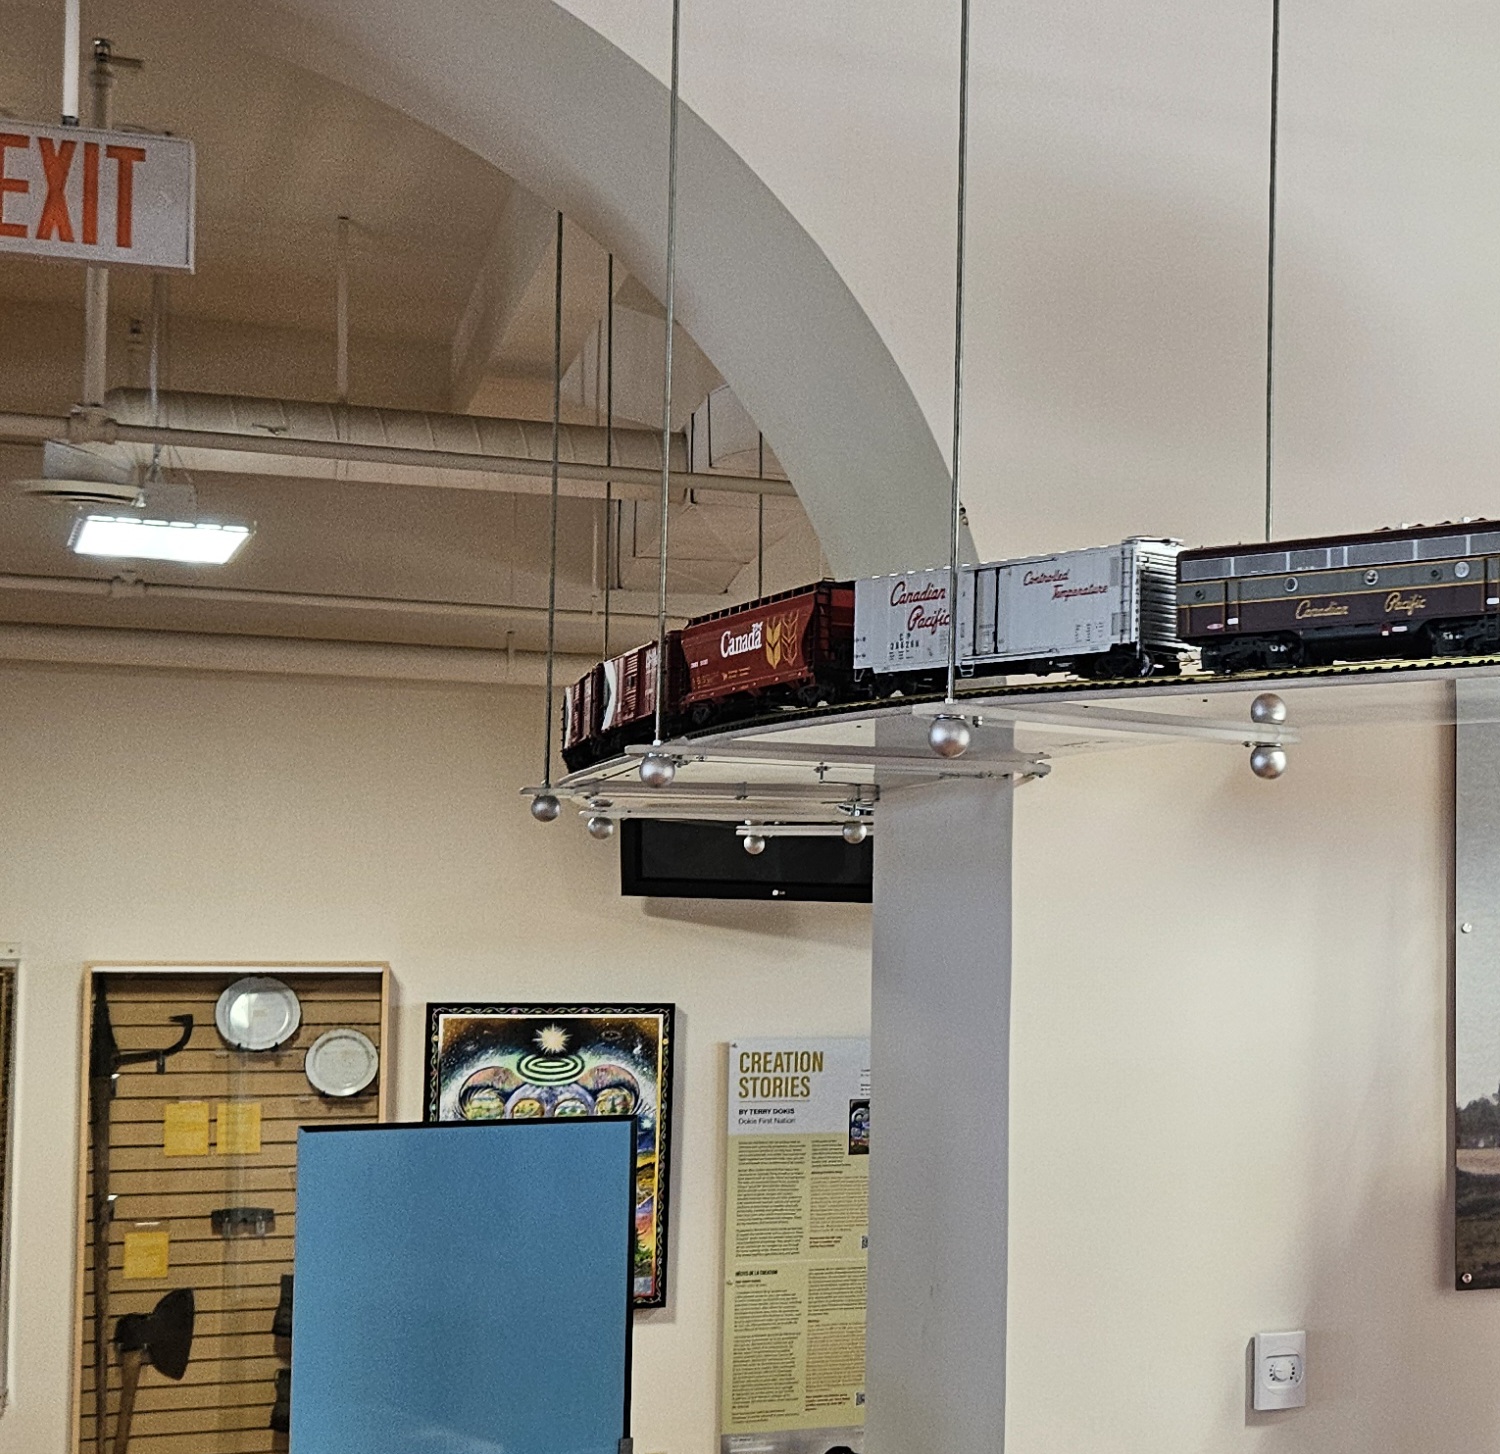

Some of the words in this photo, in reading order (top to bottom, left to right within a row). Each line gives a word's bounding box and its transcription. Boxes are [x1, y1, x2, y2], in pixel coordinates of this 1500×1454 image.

[0, 133, 146, 249] EXIT
[1023, 569, 1070, 587] Controlled
[889, 580, 946, 607] Canadian
[1295, 600, 1349, 619] Canadian
[1384, 592, 1426, 616] Pacific
[907, 604, 951, 635] Pacific
[720, 624, 763, 658] Canada
[739, 1051, 824, 1074] CREATION
[739, 1076, 811, 1099] STORIES
[772, 1107, 795, 1115] DOKIS
